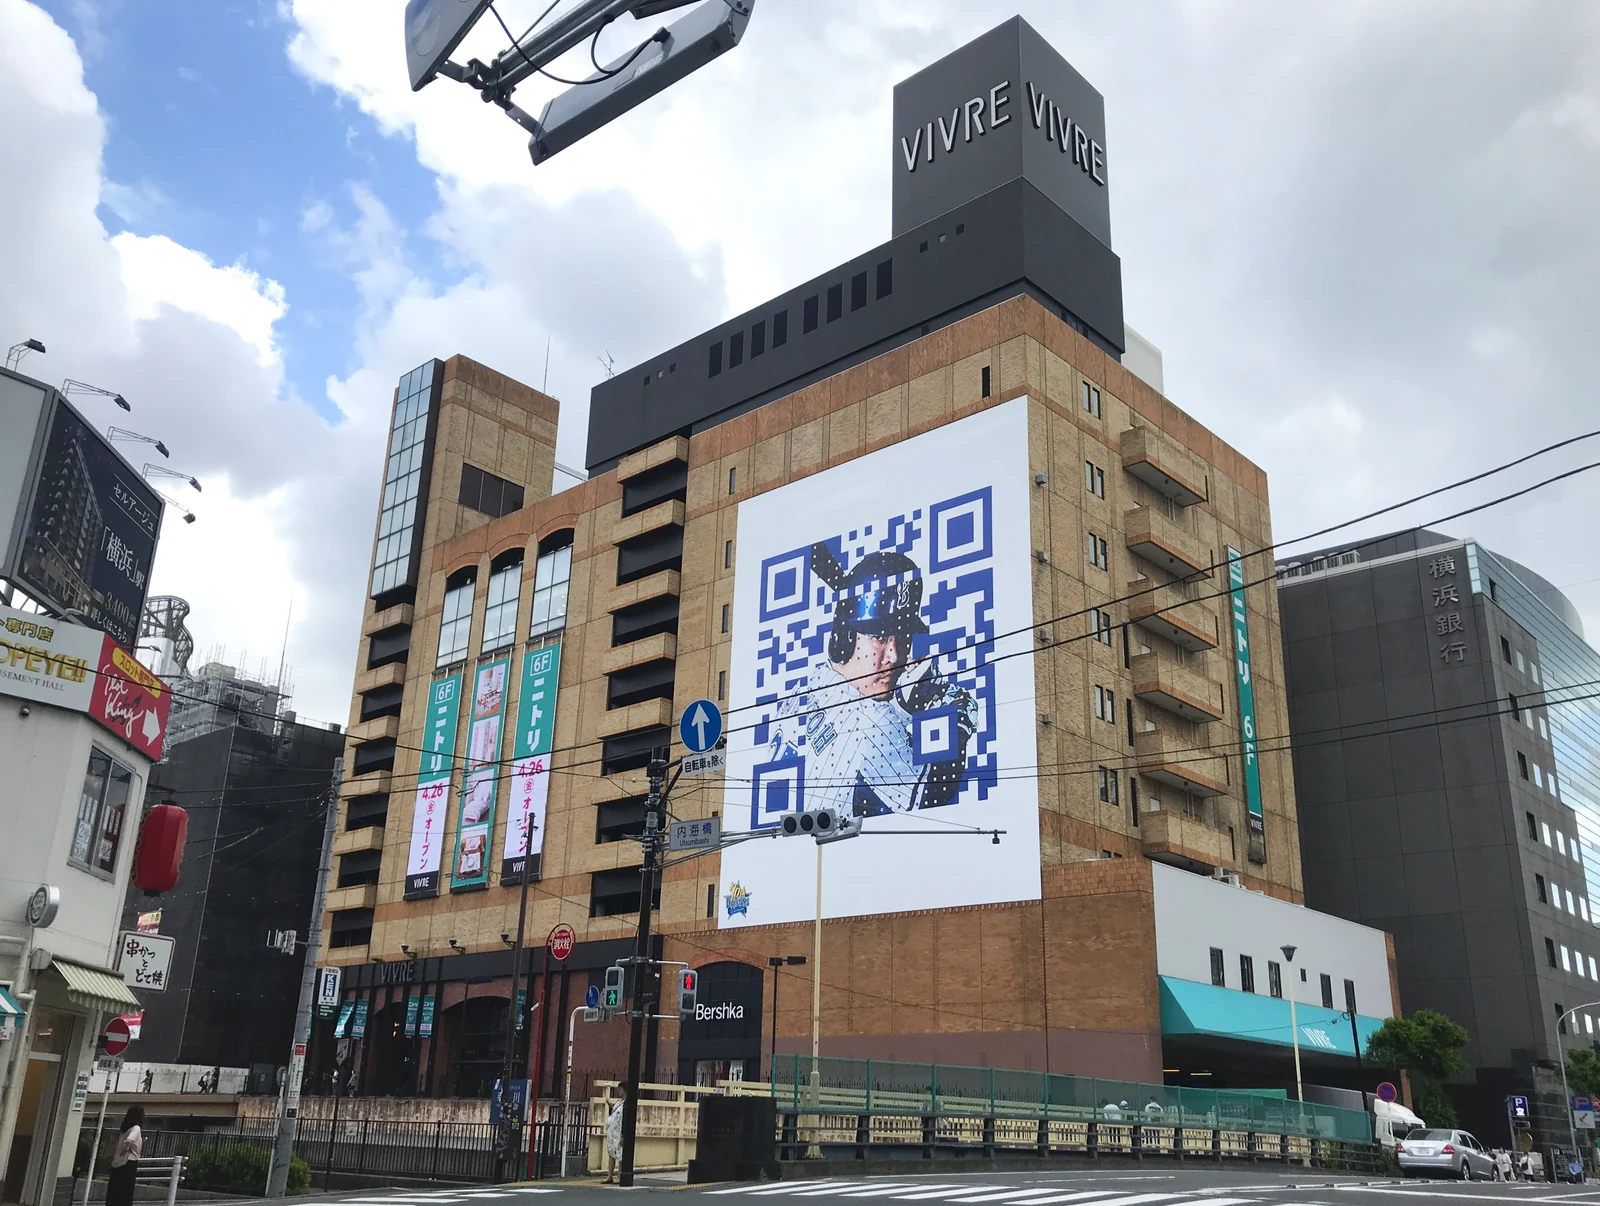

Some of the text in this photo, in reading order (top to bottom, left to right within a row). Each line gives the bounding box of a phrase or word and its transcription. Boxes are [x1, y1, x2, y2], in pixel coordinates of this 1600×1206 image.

[901, 80, 1011, 172] VIVRE
[1026, 81, 1104, 186] VIVRE
[113, 483, 155, 532] セルアージュ
[1429, 556, 1467, 664] 横浜銀行
[1234, 597, 1250, 685] ニトリ
[119, 655, 155, 692] スロット専門店
[533, 654, 549, 673] 6F
[0, 670, 65, 691] SEMENT HALL
[438, 684, 452, 700] 6F
[105, 691, 144, 739] King
[527, 677, 545, 752] ニトリ
[431, 705, 447, 776] ニトリ
[1244, 715, 1255, 766] 6F
[518, 758, 543, 778] 4.26
[685, 755, 724, 773] 自転車を除く
[422, 783, 443, 800] 4.26
[677, 822, 712, 838] 内海橋
[420, 817, 432, 870] オープン
[413, 877, 430, 889] VIVRE
[126, 939, 155, 958] 串かつ
[142, 959, 148, 967] と
[381, 960, 415, 984] VIVRE
[135, 968, 163, 986] どて焼
[325, 974, 335, 997] KEN
[696, 1002, 744, 1020] Bershka
[1300, 1026, 1336, 1049] VIVRE
[1515, 1097, 1523, 1107] P
